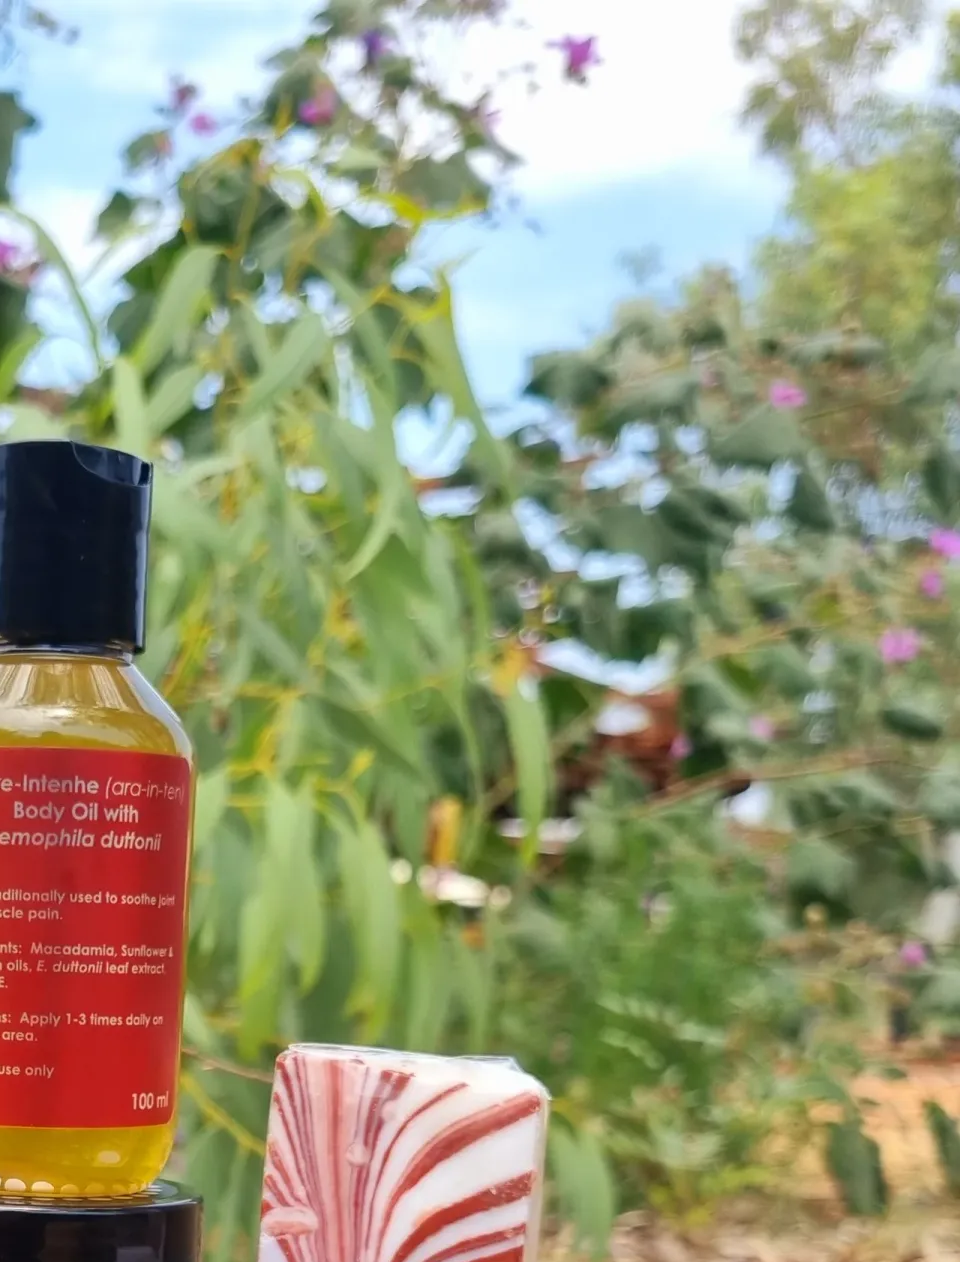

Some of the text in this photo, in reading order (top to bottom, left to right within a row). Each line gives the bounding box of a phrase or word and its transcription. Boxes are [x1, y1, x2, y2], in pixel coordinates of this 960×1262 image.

[13, 801, 139, 824] Body Oil with
[100, 830, 162, 851] duttonii
[69, 890, 102, 905] used
[105, 892, 118, 905] to
[121, 892, 156, 906] soothe
[158, 895, 175, 909] joint
[28, 908, 63, 923] pain.
[30, 942, 118, 959] Macadamia,
[121, 944, 168, 958] Sunflower
[36, 960, 48, 973] E.
[52, 960, 104, 975] duttonii
[105, 961, 130, 975] leaf
[20, 1011, 61, 1028] Apply
[65, 1012, 87, 1026] 1-3
[90, 1012, 123, 1027] times
[125, 1013, 151, 1029] daily
[152, 1014, 164, 1026] on
[1, 1029, 38, 1043] area.
[24, 1064, 55, 1080] only
[131, 1091, 169, 1111] 100 ml
